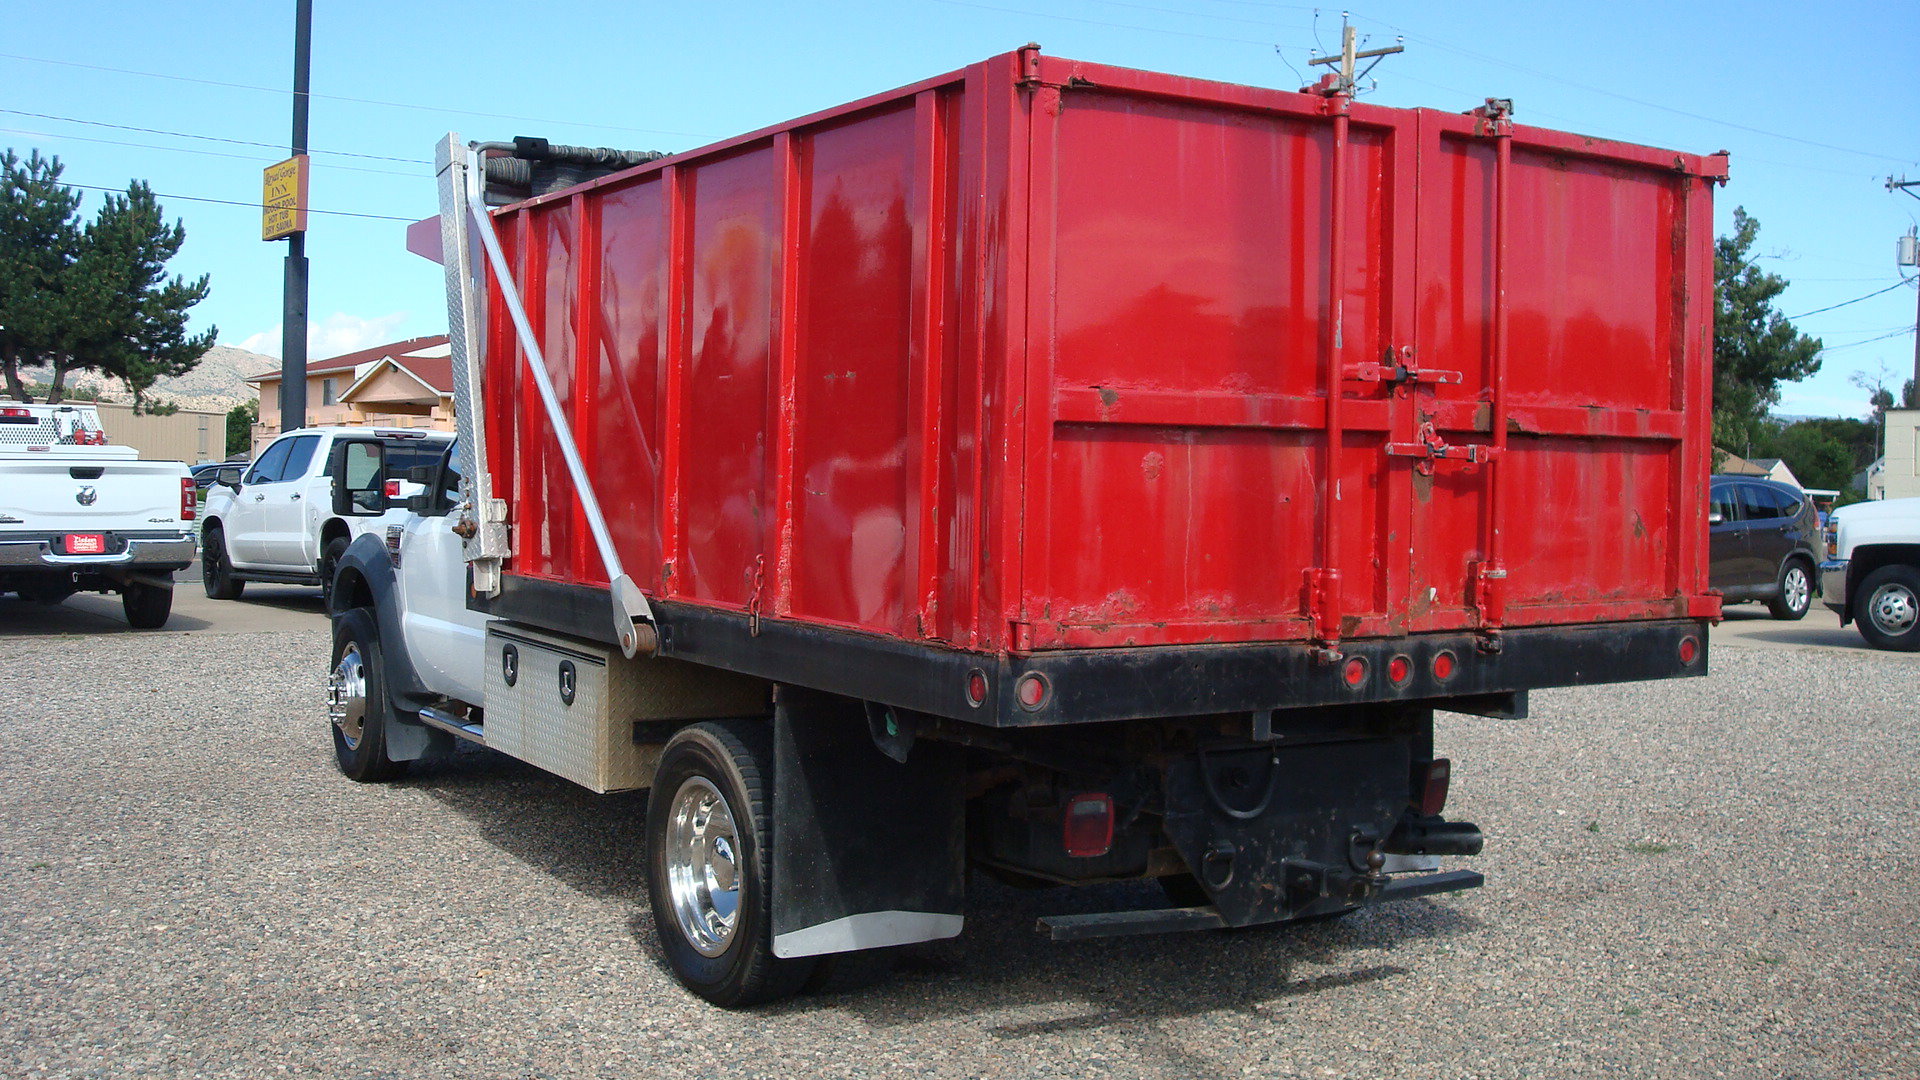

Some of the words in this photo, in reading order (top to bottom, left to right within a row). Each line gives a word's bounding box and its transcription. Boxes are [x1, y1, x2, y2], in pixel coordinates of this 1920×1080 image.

[279, 166, 296, 179] Gorge
[272, 184, 287, 197] INN
[282, 197, 296, 208] POOL
[268, 213, 278, 224] HOT
[280, 210, 289, 220] TUB
